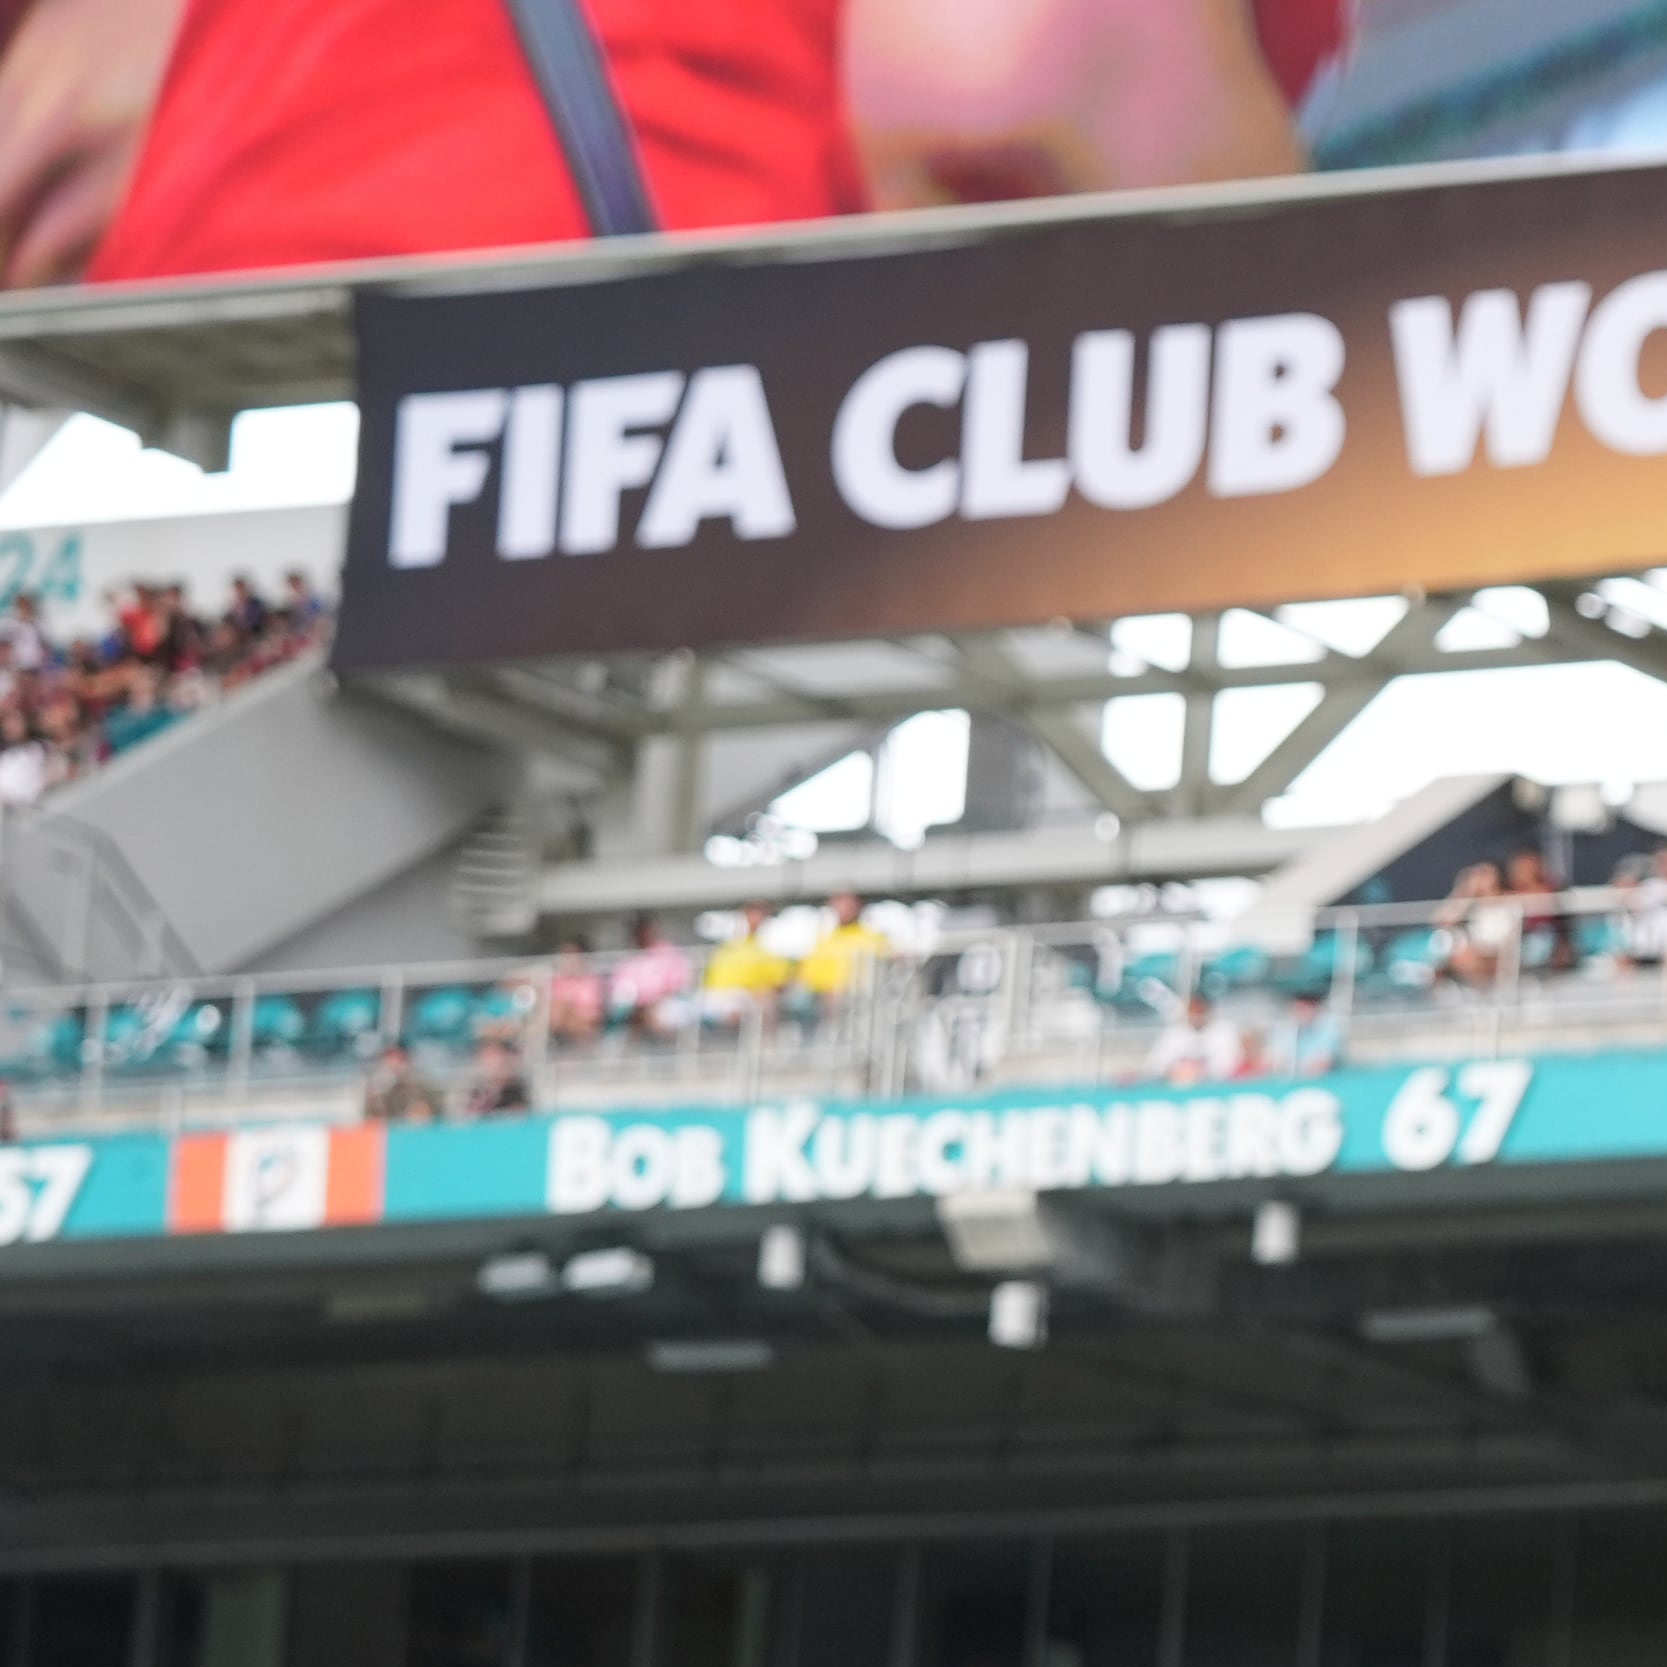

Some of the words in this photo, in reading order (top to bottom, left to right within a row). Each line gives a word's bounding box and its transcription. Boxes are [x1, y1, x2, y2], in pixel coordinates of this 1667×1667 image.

[390, 365, 796, 567] FIFA
[832, 314, 1348, 529] CLUB
[544, 1114, 727, 1215] BOB
[745, 1086, 1342, 1205] KUECHENBERG
[1382, 1060, 1534, 1172] 67
